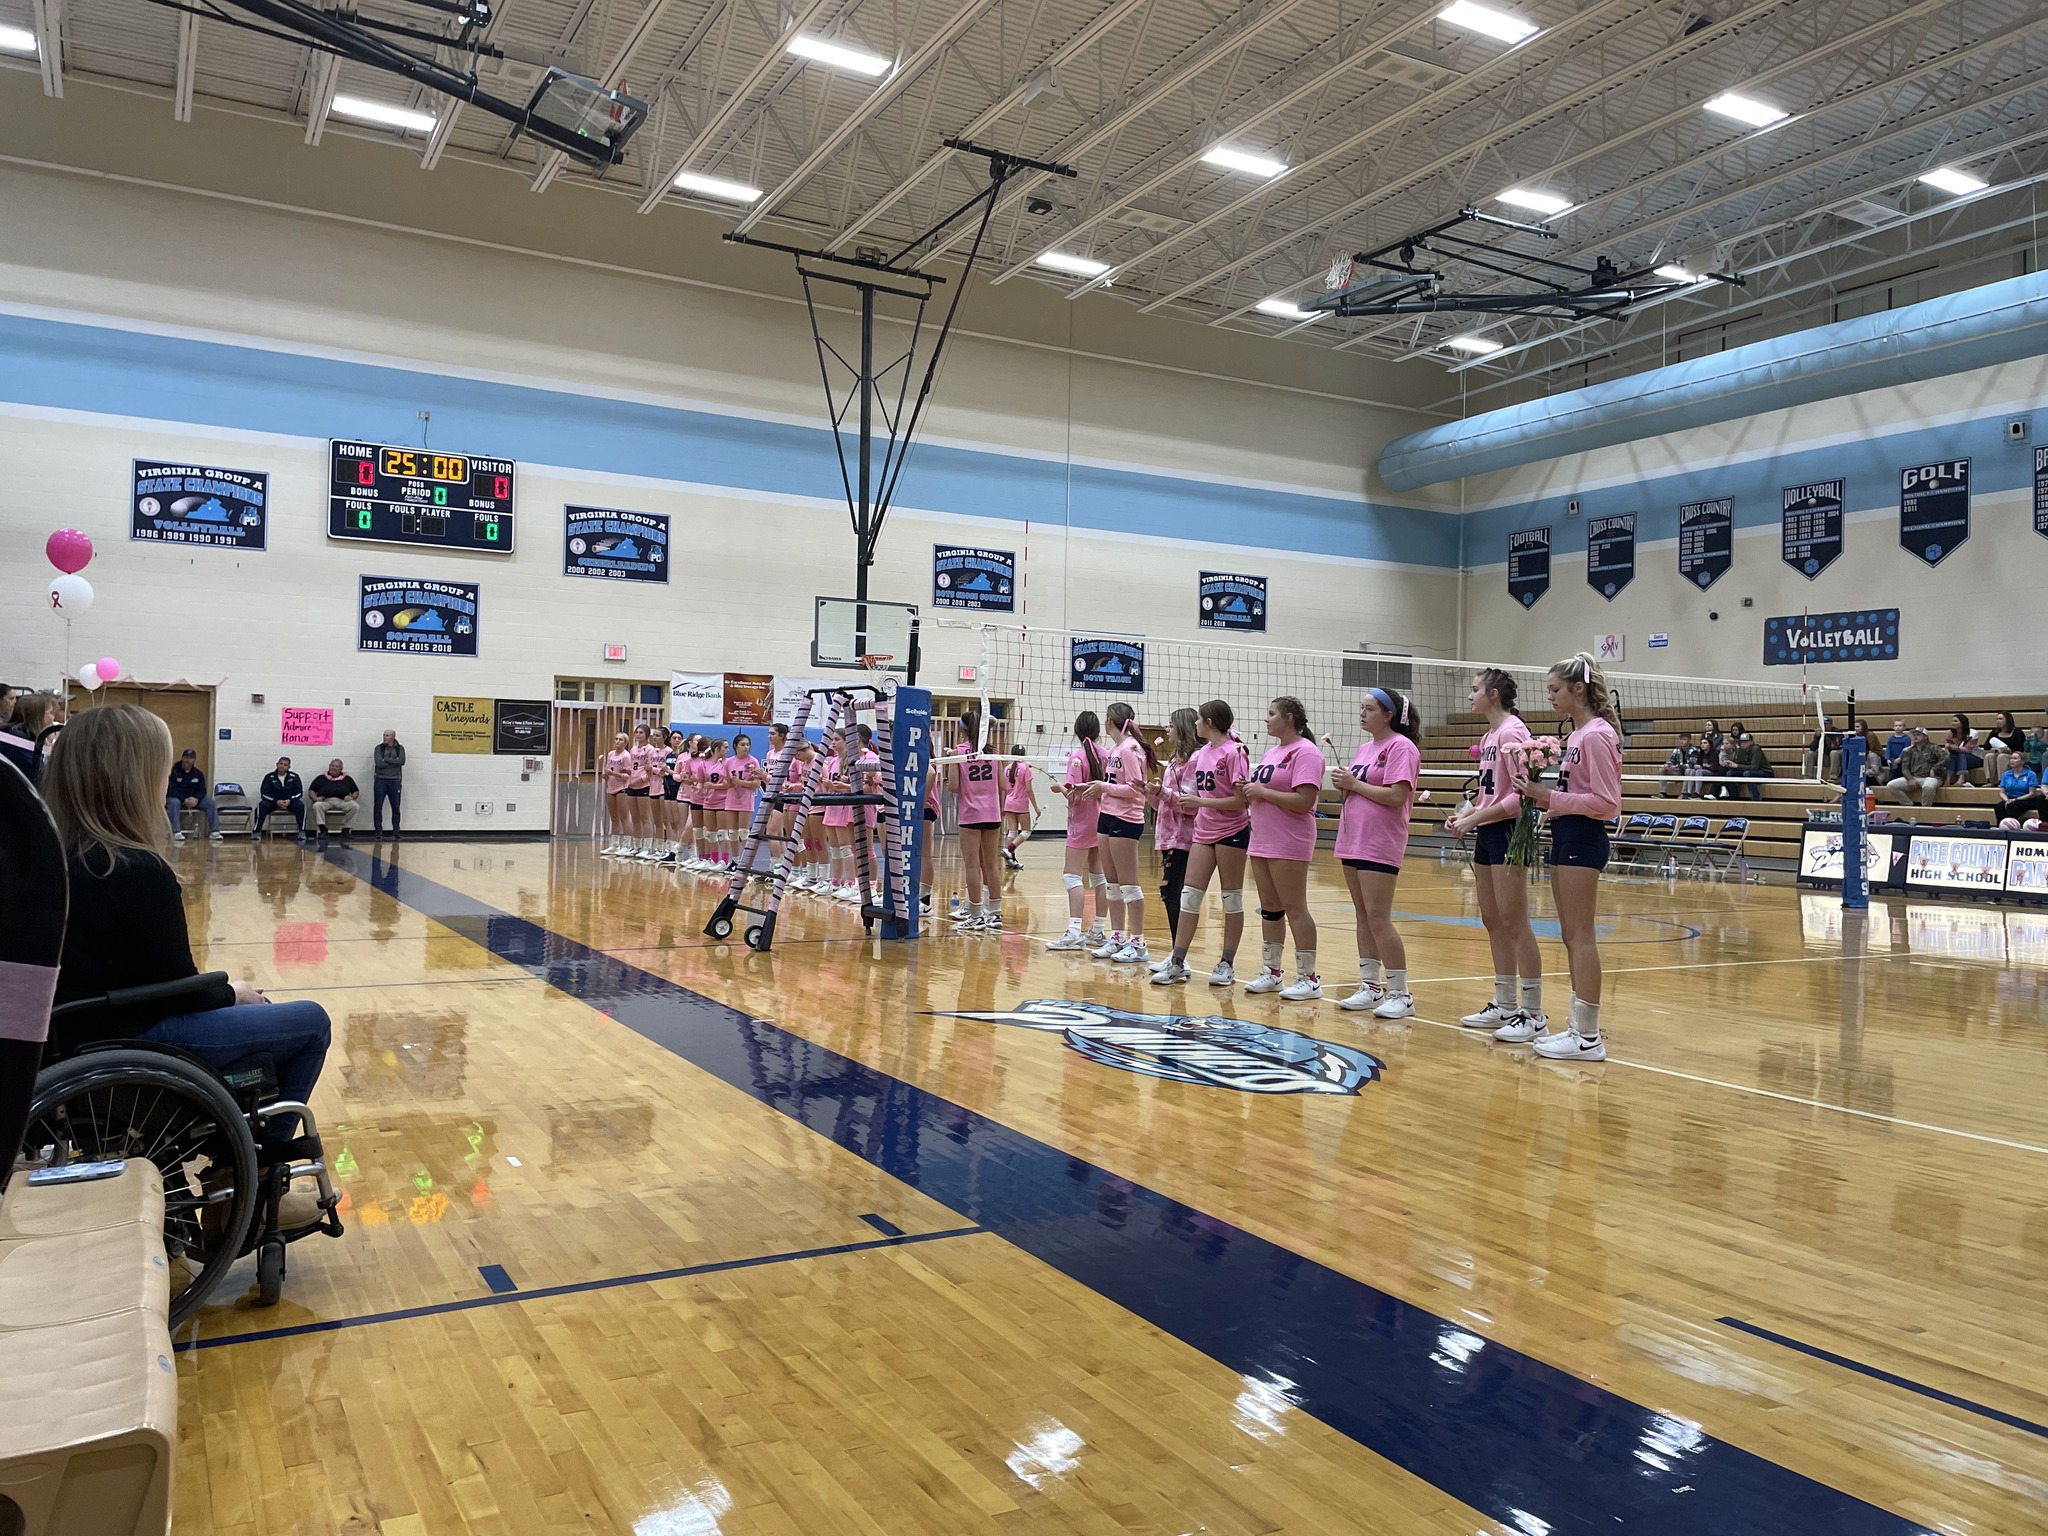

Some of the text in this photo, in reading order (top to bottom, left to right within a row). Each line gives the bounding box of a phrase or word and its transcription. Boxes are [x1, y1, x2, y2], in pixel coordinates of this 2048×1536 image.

[339, 444, 373, 458] HOME
[358, 462, 374, 485] 0
[387, 451, 463, 480] 25:00
[471, 460, 512, 474] VISITOR
[138, 467, 263, 490] VIRGINIA GROUP A
[1903, 461, 1967, 490] GOLF
[137, 477, 263, 507] STATE CHAMPIONS
[351, 487, 378, 497] BONUS
[401, 487, 431, 497] PERIOD
[494, 476, 508, 499] 0
[434, 487, 447, 505] 0
[1784, 482, 1841, 510] VOLLEYBALL
[346, 501, 372, 510] FOULS
[390, 505, 450, 518] FOULS PLAYER
[468, 500, 495, 509] BONUS
[1681, 499, 1732, 525] CROSS COUNTRY
[358, 511, 372, 529] 0
[474, 513, 499, 522] FOULS
[568, 511, 666, 531] VIRGINIA GROUP A
[154, 520, 245, 537] VOLLEYBALL
[486, 523, 499, 541] 0
[568, 520, 666, 545] STATE CHAMPIONS
[1590, 515, 1634, 538] CROSS COUNTRY
[136, 528, 236, 545] 1986 1989 1990 1991
[1510, 529, 1549, 551] FOOTBALL
[937, 550, 975, 558] VIRGINIA
[977, 550, 1005, 562] GROUP
[568, 566, 626, 577] 2000 2002 2003
[936, 557, 1012, 578] STATE CHAMPIONS
[1202, 575, 1233, 584] VIRGINIA
[1235, 576, 1259, 586] GROUP
[364, 581, 475, 600] VIRGINIA GROUP A
[1225, 582, 1265, 601] CHAMPIONS
[363, 590, 475, 616] STATE CHAMPIONS
[362, 640, 382, 648] 1981
[386, 641, 406, 650] 2014
[409, 643, 429, 651] 2015
[386, 631, 452, 644] SOFTBALL
[609, 647, 622, 657] EXIT
[687, 691, 705, 699] Ridge
[437, 701, 474, 713] CASTLE
[285, 708, 331, 723] Support
[445, 713, 490, 726] Vineyards
[283, 721, 312, 731] Admire
[282, 732, 310, 742] Honor
[710, 773, 719, 783] 8
[968, 764, 993, 781] 22
[1196, 770, 1216, 791] 26
[900, 727, 922, 919] PANTHER
[1631, 815, 1650, 825] PAGE
[1654, 816, 1674, 826] PAGE
[1684, 818, 1705, 827] PAGE
[1725, 819, 1746, 829] PAGE
[1858, 764, 1869, 896] PANTHERS
[1910, 840, 2006, 870] PAGE COUNTY
[1911, 869, 2001, 884] HIGH SCHOOL
